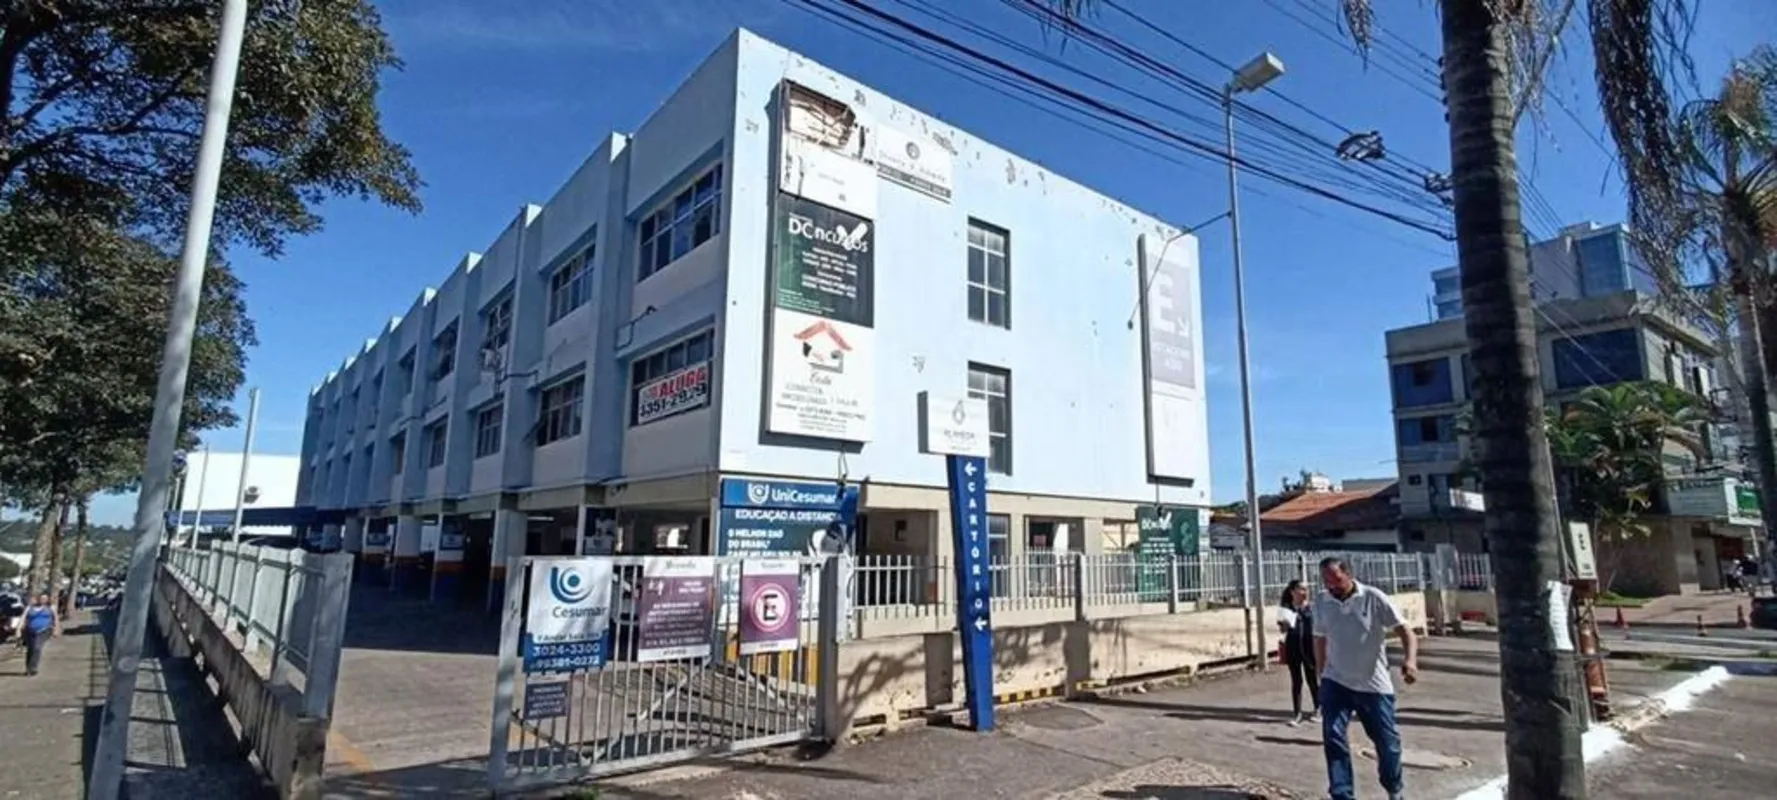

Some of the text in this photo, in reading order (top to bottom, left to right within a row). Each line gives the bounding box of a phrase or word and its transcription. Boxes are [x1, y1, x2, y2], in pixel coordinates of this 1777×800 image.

[771, 487, 836, 504] UniCesumar
[789, 510, 797, 520] A
[552, 606, 606, 618] Cesumar
[763, 594, 778, 621] E
[532, 643, 600, 657] 3024-3300
